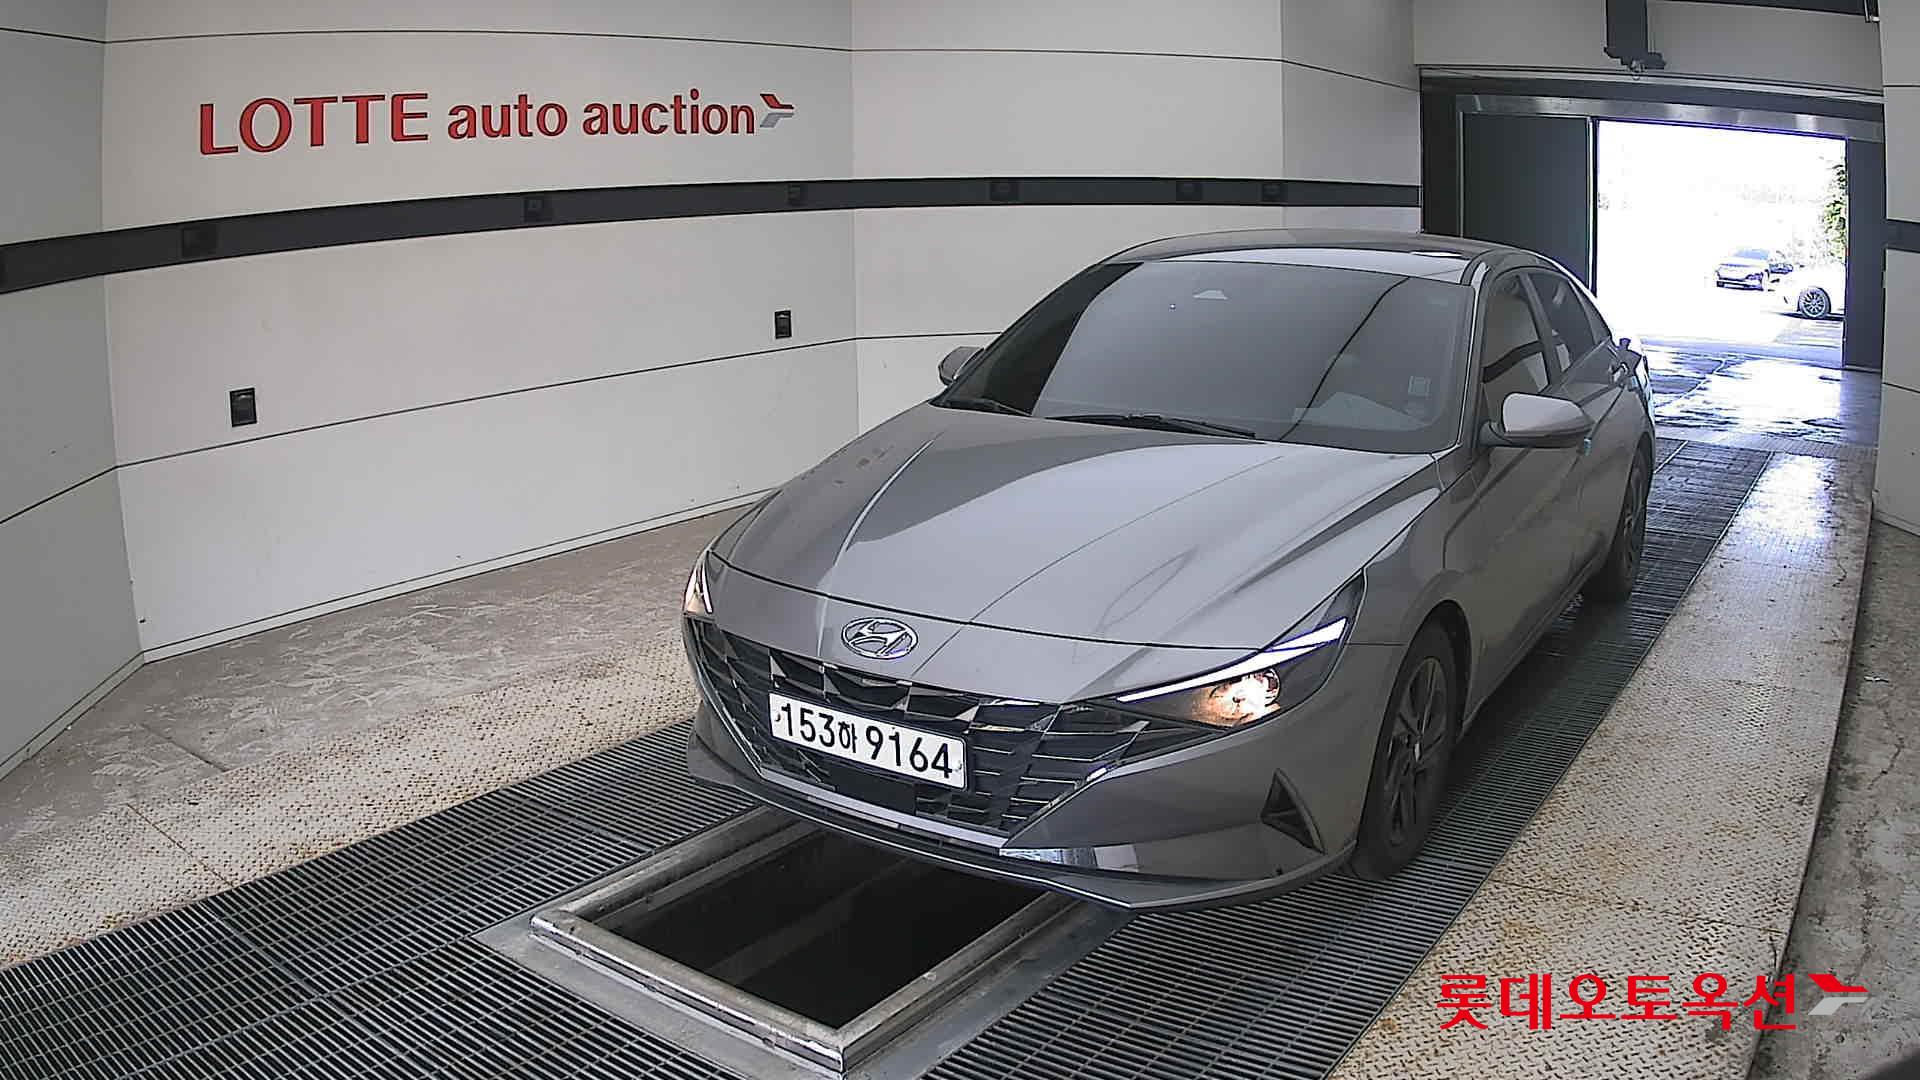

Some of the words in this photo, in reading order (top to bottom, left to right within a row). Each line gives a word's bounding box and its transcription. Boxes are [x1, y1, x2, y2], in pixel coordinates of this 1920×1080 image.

[199, 92, 429, 156] LOTTE
[446, 93, 568, 140] auto
[582, 88, 756, 136] auction
[780, 702, 859, 754] 153하
[865, 725, 953, 779] 9164
